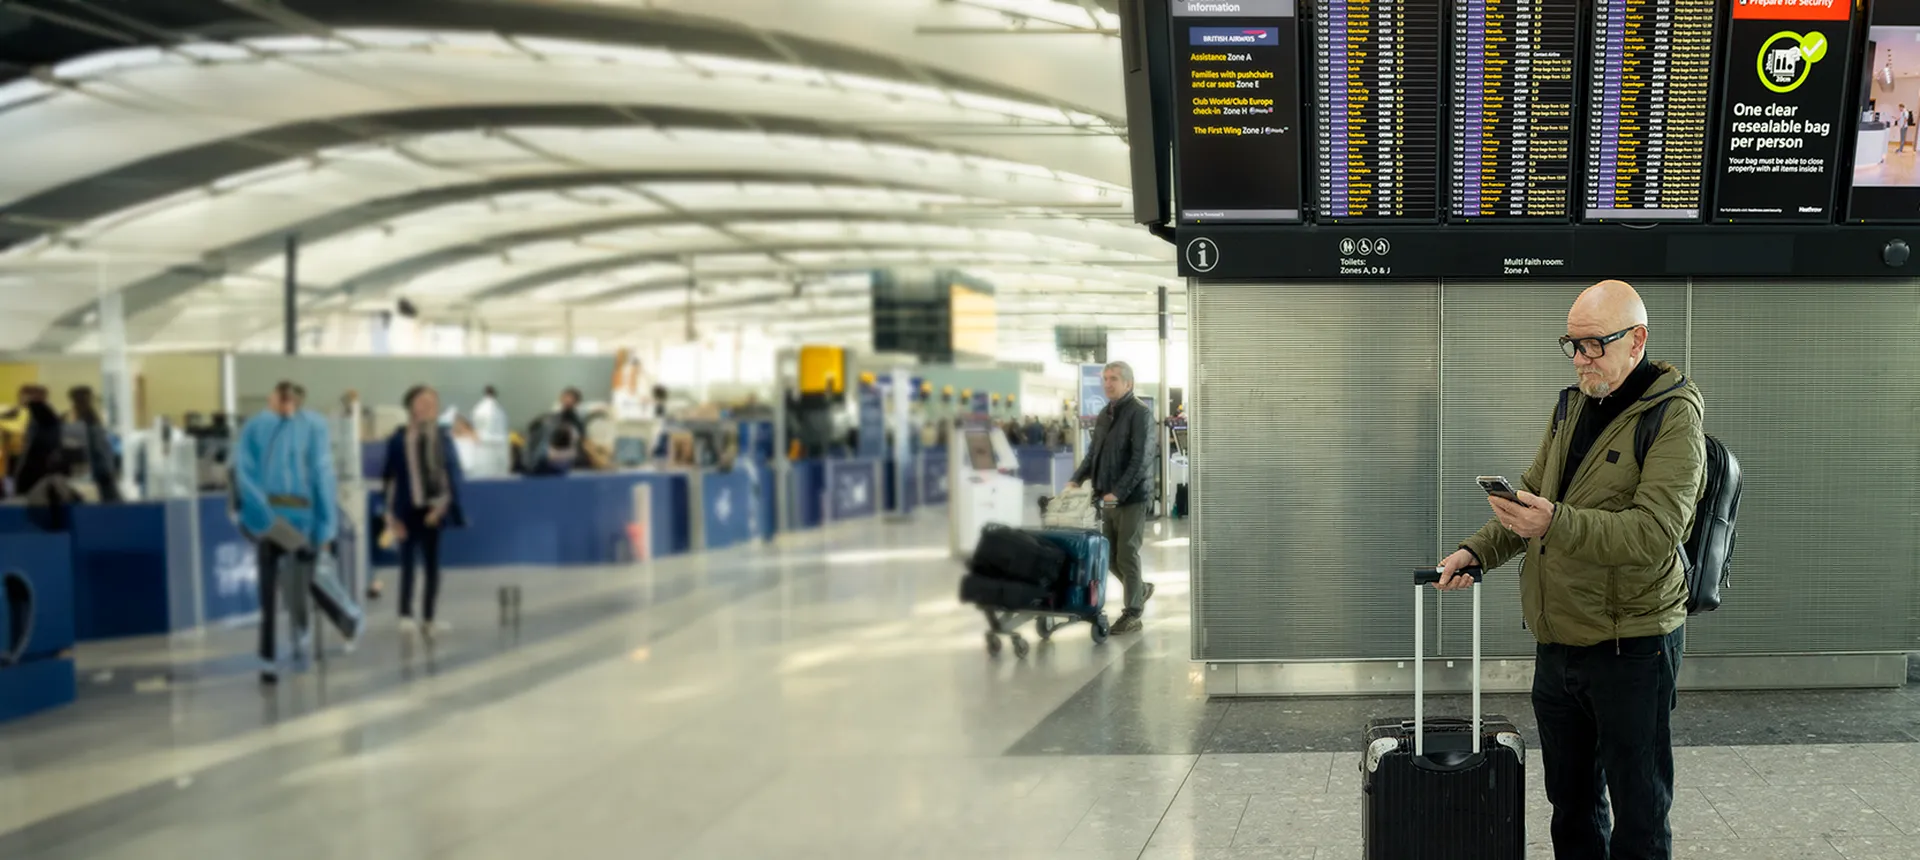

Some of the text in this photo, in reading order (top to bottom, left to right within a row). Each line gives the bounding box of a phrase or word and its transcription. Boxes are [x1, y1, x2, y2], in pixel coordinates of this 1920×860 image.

[1188, 2, 1240, 12] information
[1237, 71, 1274, 79] pushchairs
[1249, 98, 1273, 106] Europe
[1734, 103, 1798, 116] One clear
[1223, 127, 1241, 135] Wing
[1732, 120, 1830, 136] resealable bag
[1730, 137, 1803, 150] per person
